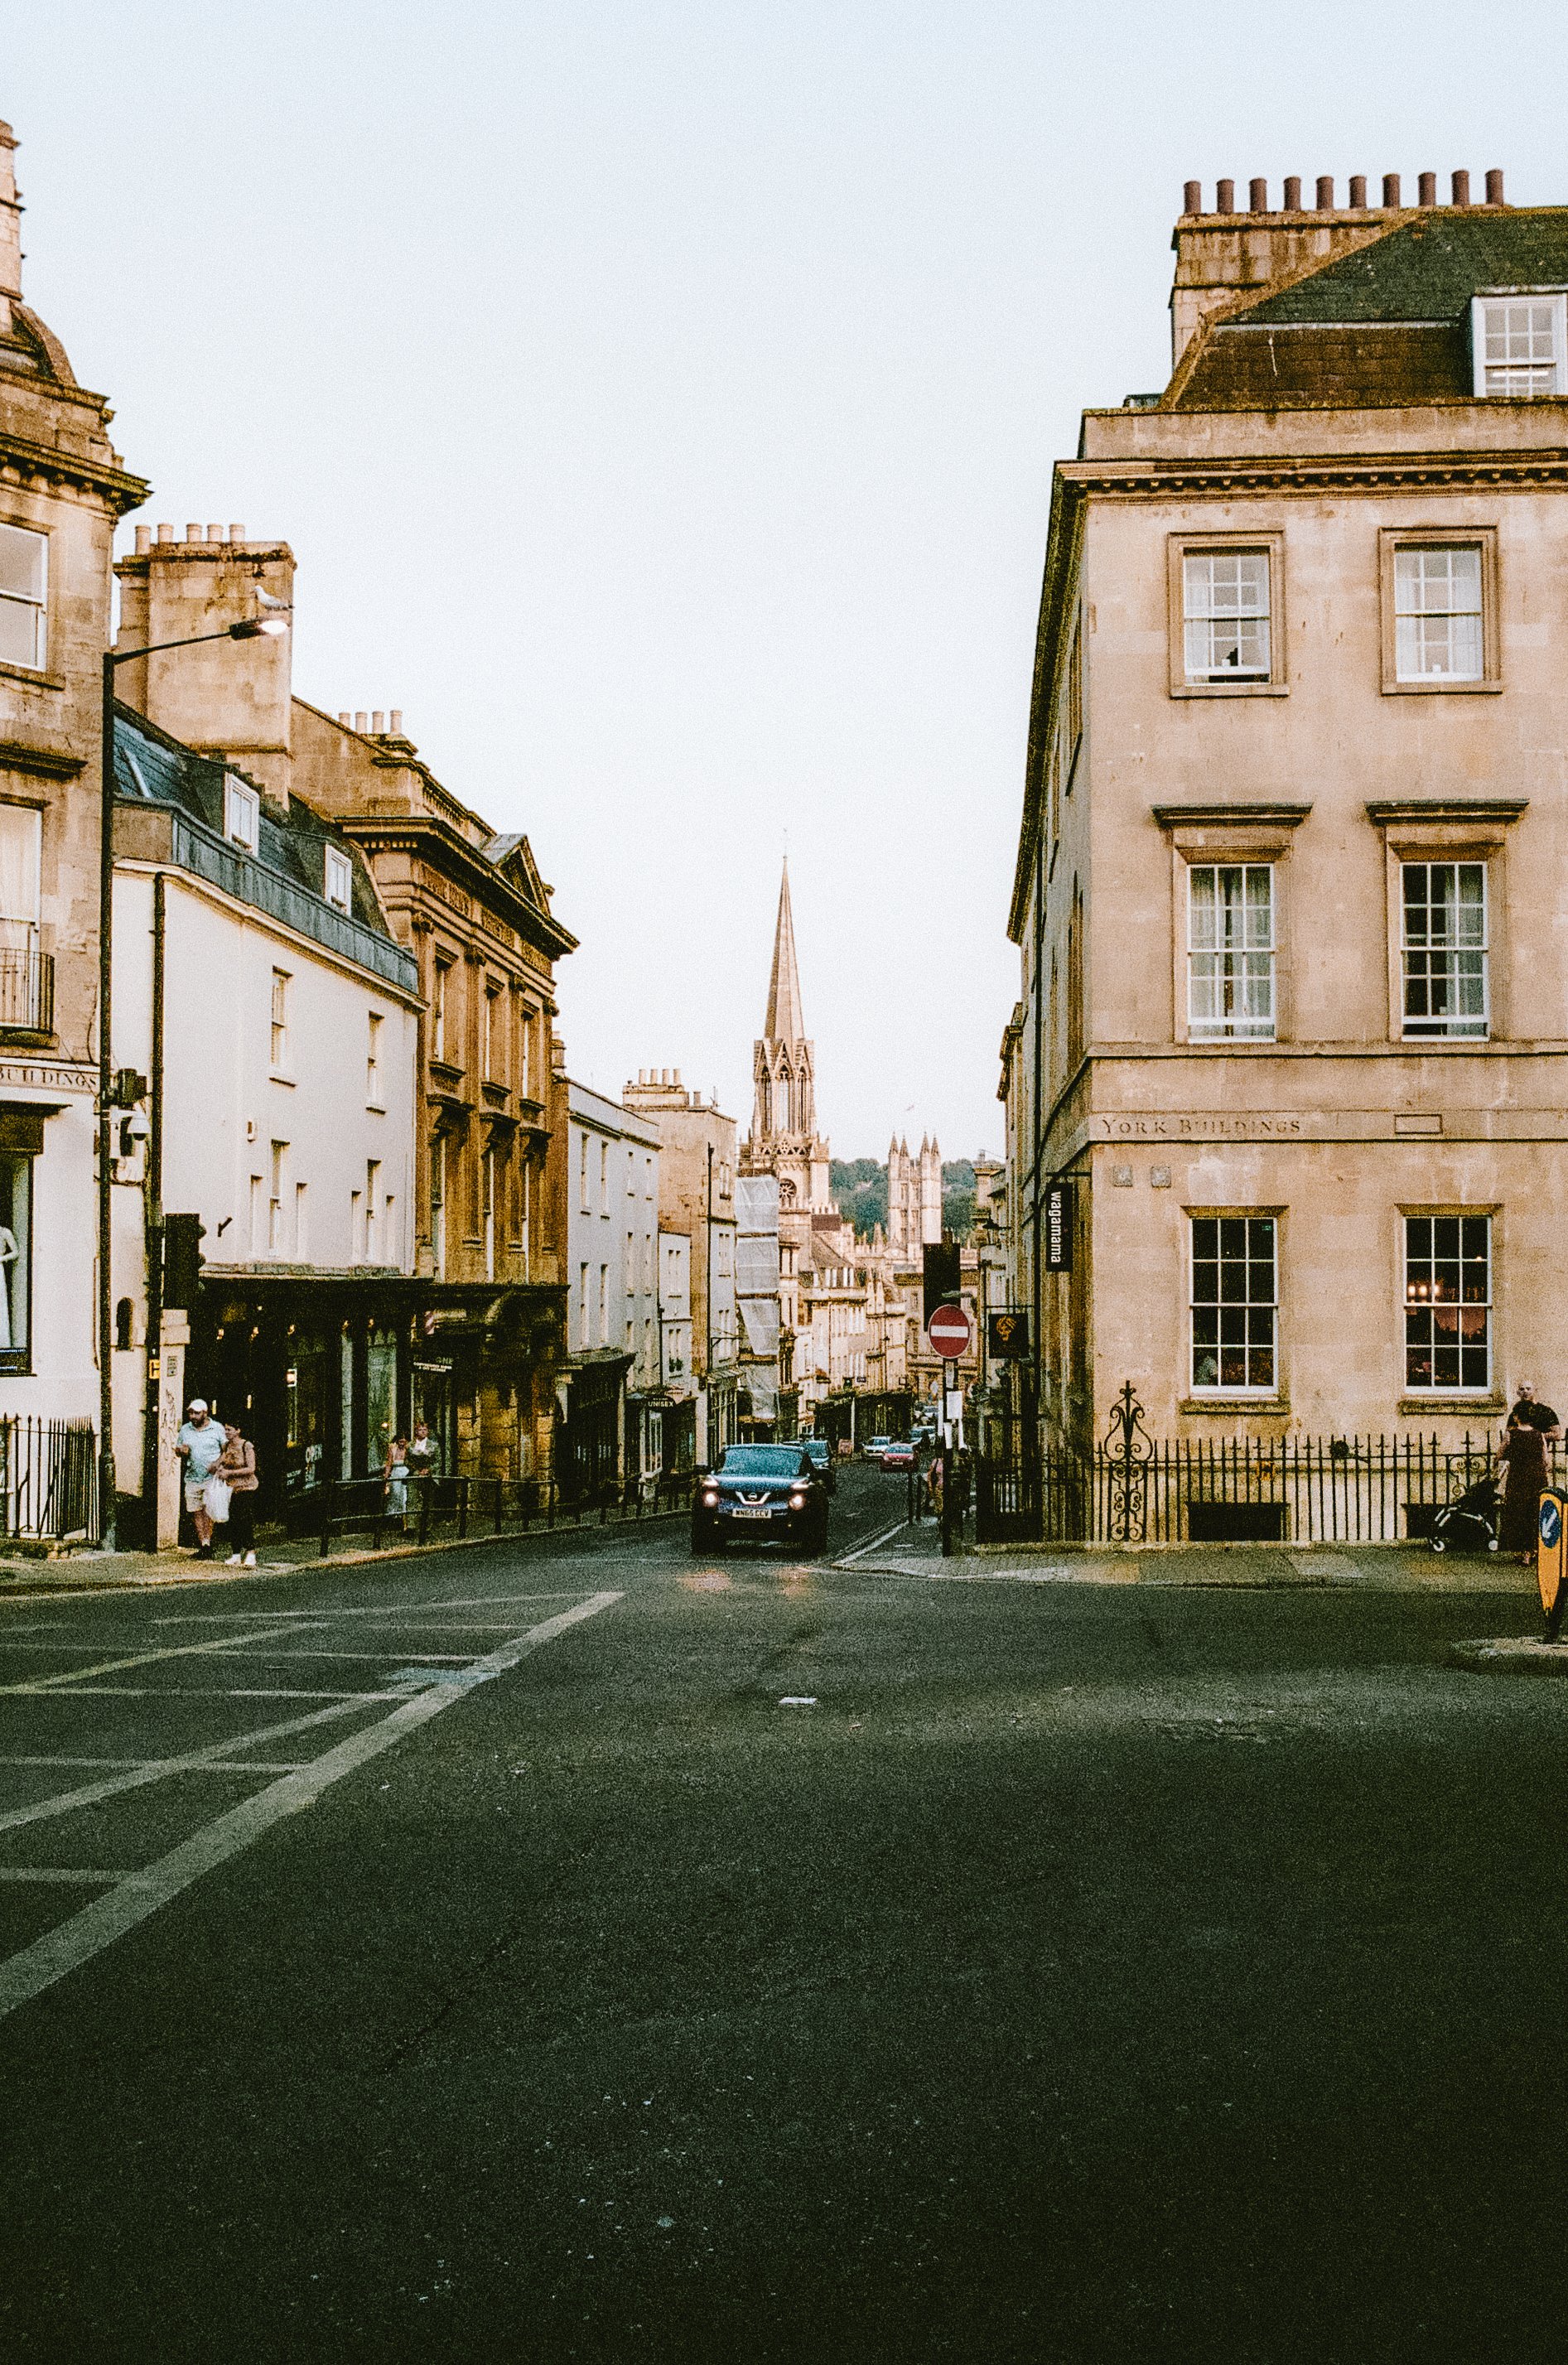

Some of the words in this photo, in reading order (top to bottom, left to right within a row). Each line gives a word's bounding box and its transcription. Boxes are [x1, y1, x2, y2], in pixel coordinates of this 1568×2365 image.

[1102, 1118, 1167, 1134] YORK
[1179, 1119, 1301, 1134] BUILDINGS
[1048, 1191, 1062, 1263] wagamama
